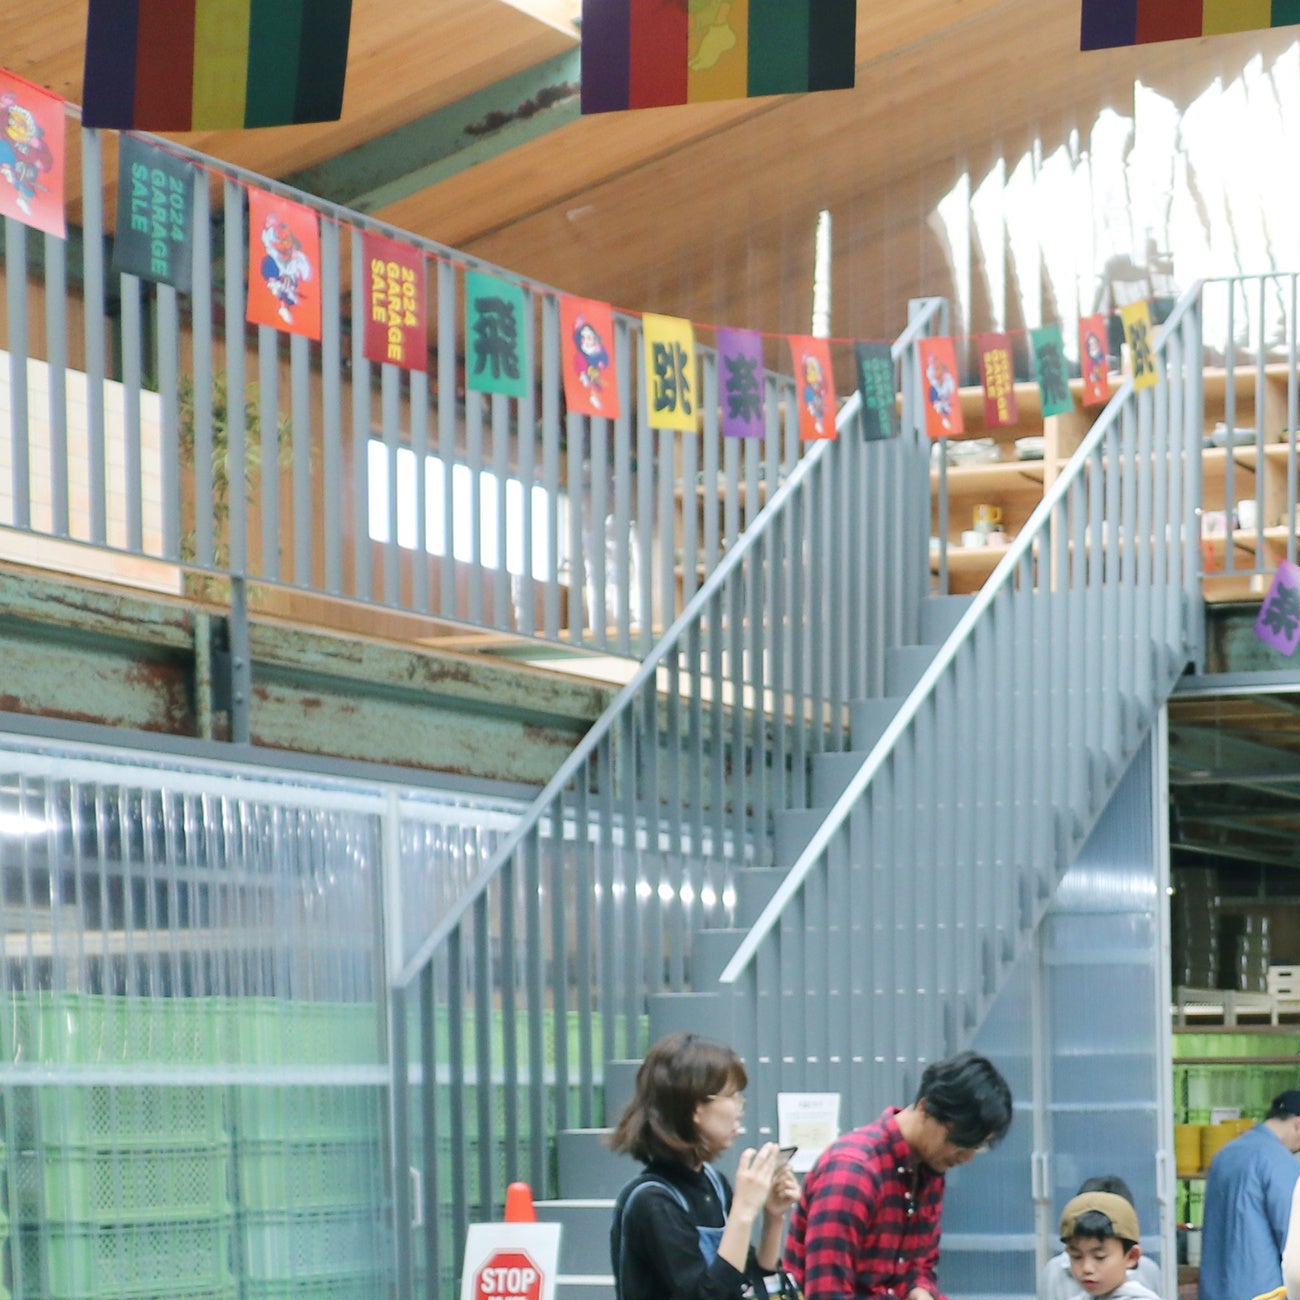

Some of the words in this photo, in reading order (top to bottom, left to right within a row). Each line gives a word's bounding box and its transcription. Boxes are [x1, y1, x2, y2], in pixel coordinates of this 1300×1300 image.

[131, 162, 148, 233] SALE
[151, 168, 169, 276] GARAGE
[169, 176, 184, 241] 2024
[371, 258, 386, 323] SALE
[386, 262, 402, 361] GARAGE
[401, 266, 417, 327] 2024
[473, 296, 521, 379] 飛
[653, 341, 692, 415] 跳
[724, 352, 762, 424] 楽
[480, 1267, 536, 1294] STOP
